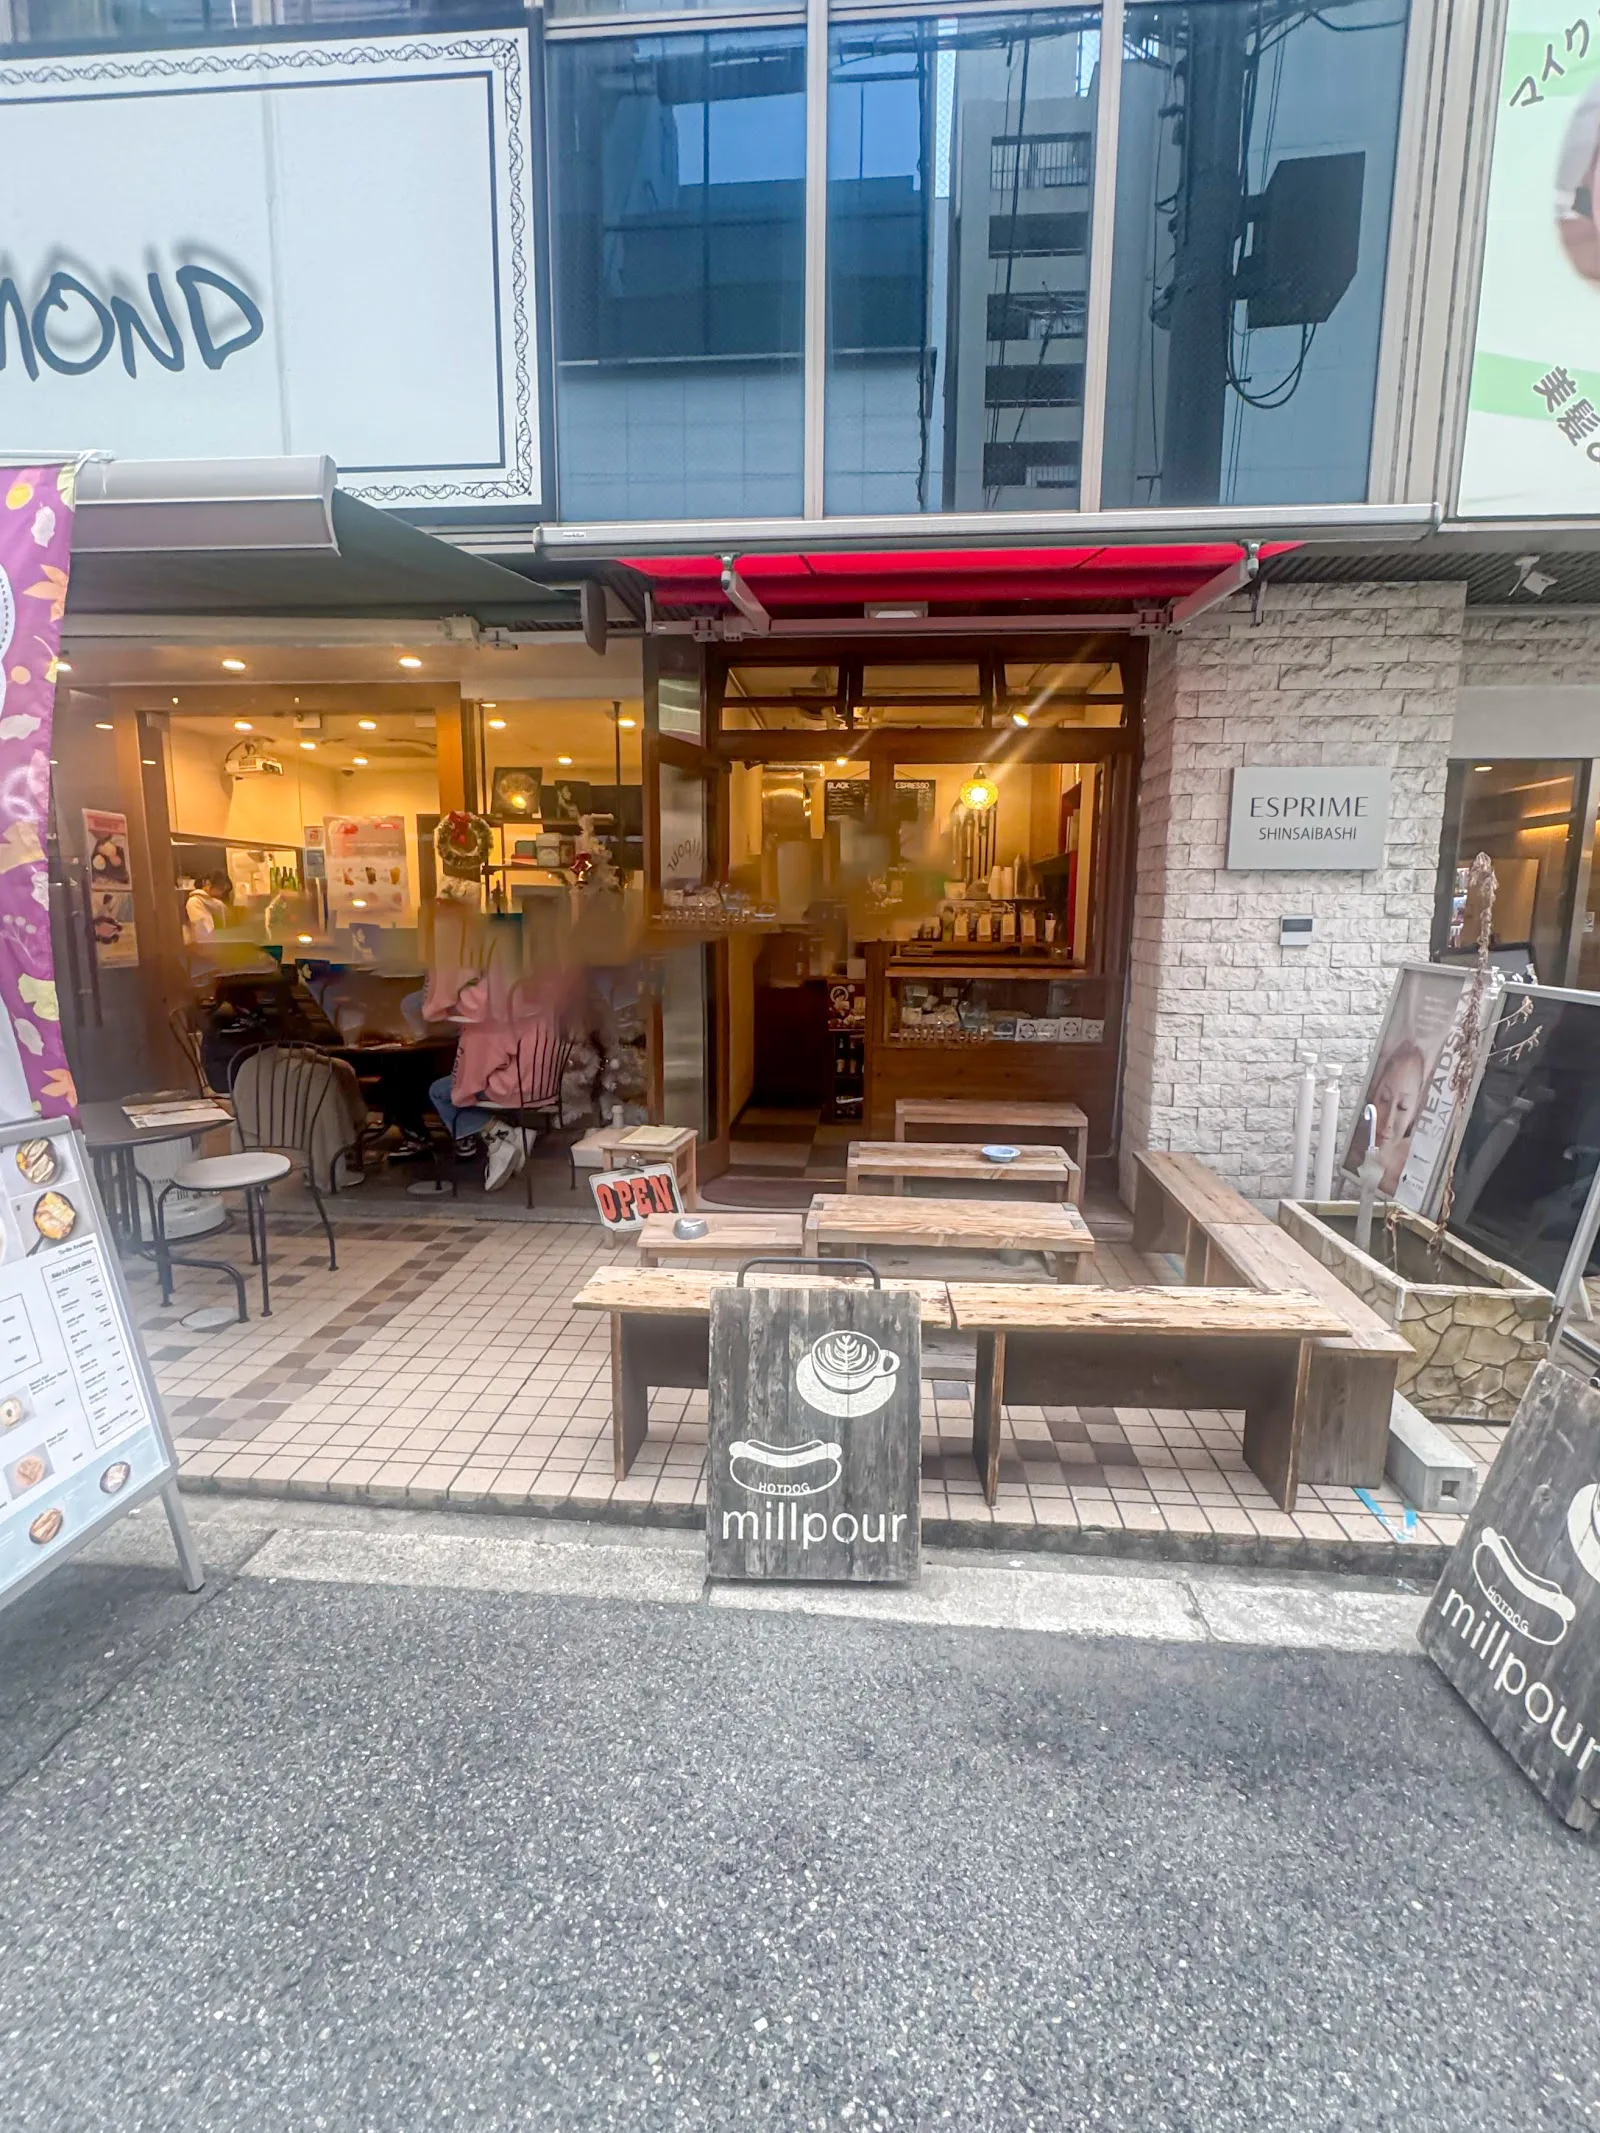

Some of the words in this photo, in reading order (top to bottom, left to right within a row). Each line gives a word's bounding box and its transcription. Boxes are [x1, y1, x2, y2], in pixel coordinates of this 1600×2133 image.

[1509, 12, 1600, 107] マイク
[895, 782, 930, 790] ESPRESSO
[1250, 796, 1369, 818] ESPRIME
[1258, 826, 1357, 841] SHINSAIBASHI
[597, 1174, 679, 1223] OPEN
[759, 1482, 811, 1495] HOTDOG
[722, 1501, 908, 1550] millpour
[1487, 1585, 1530, 1633] HOTDOG
[1441, 1588, 1600, 1770] millpour
